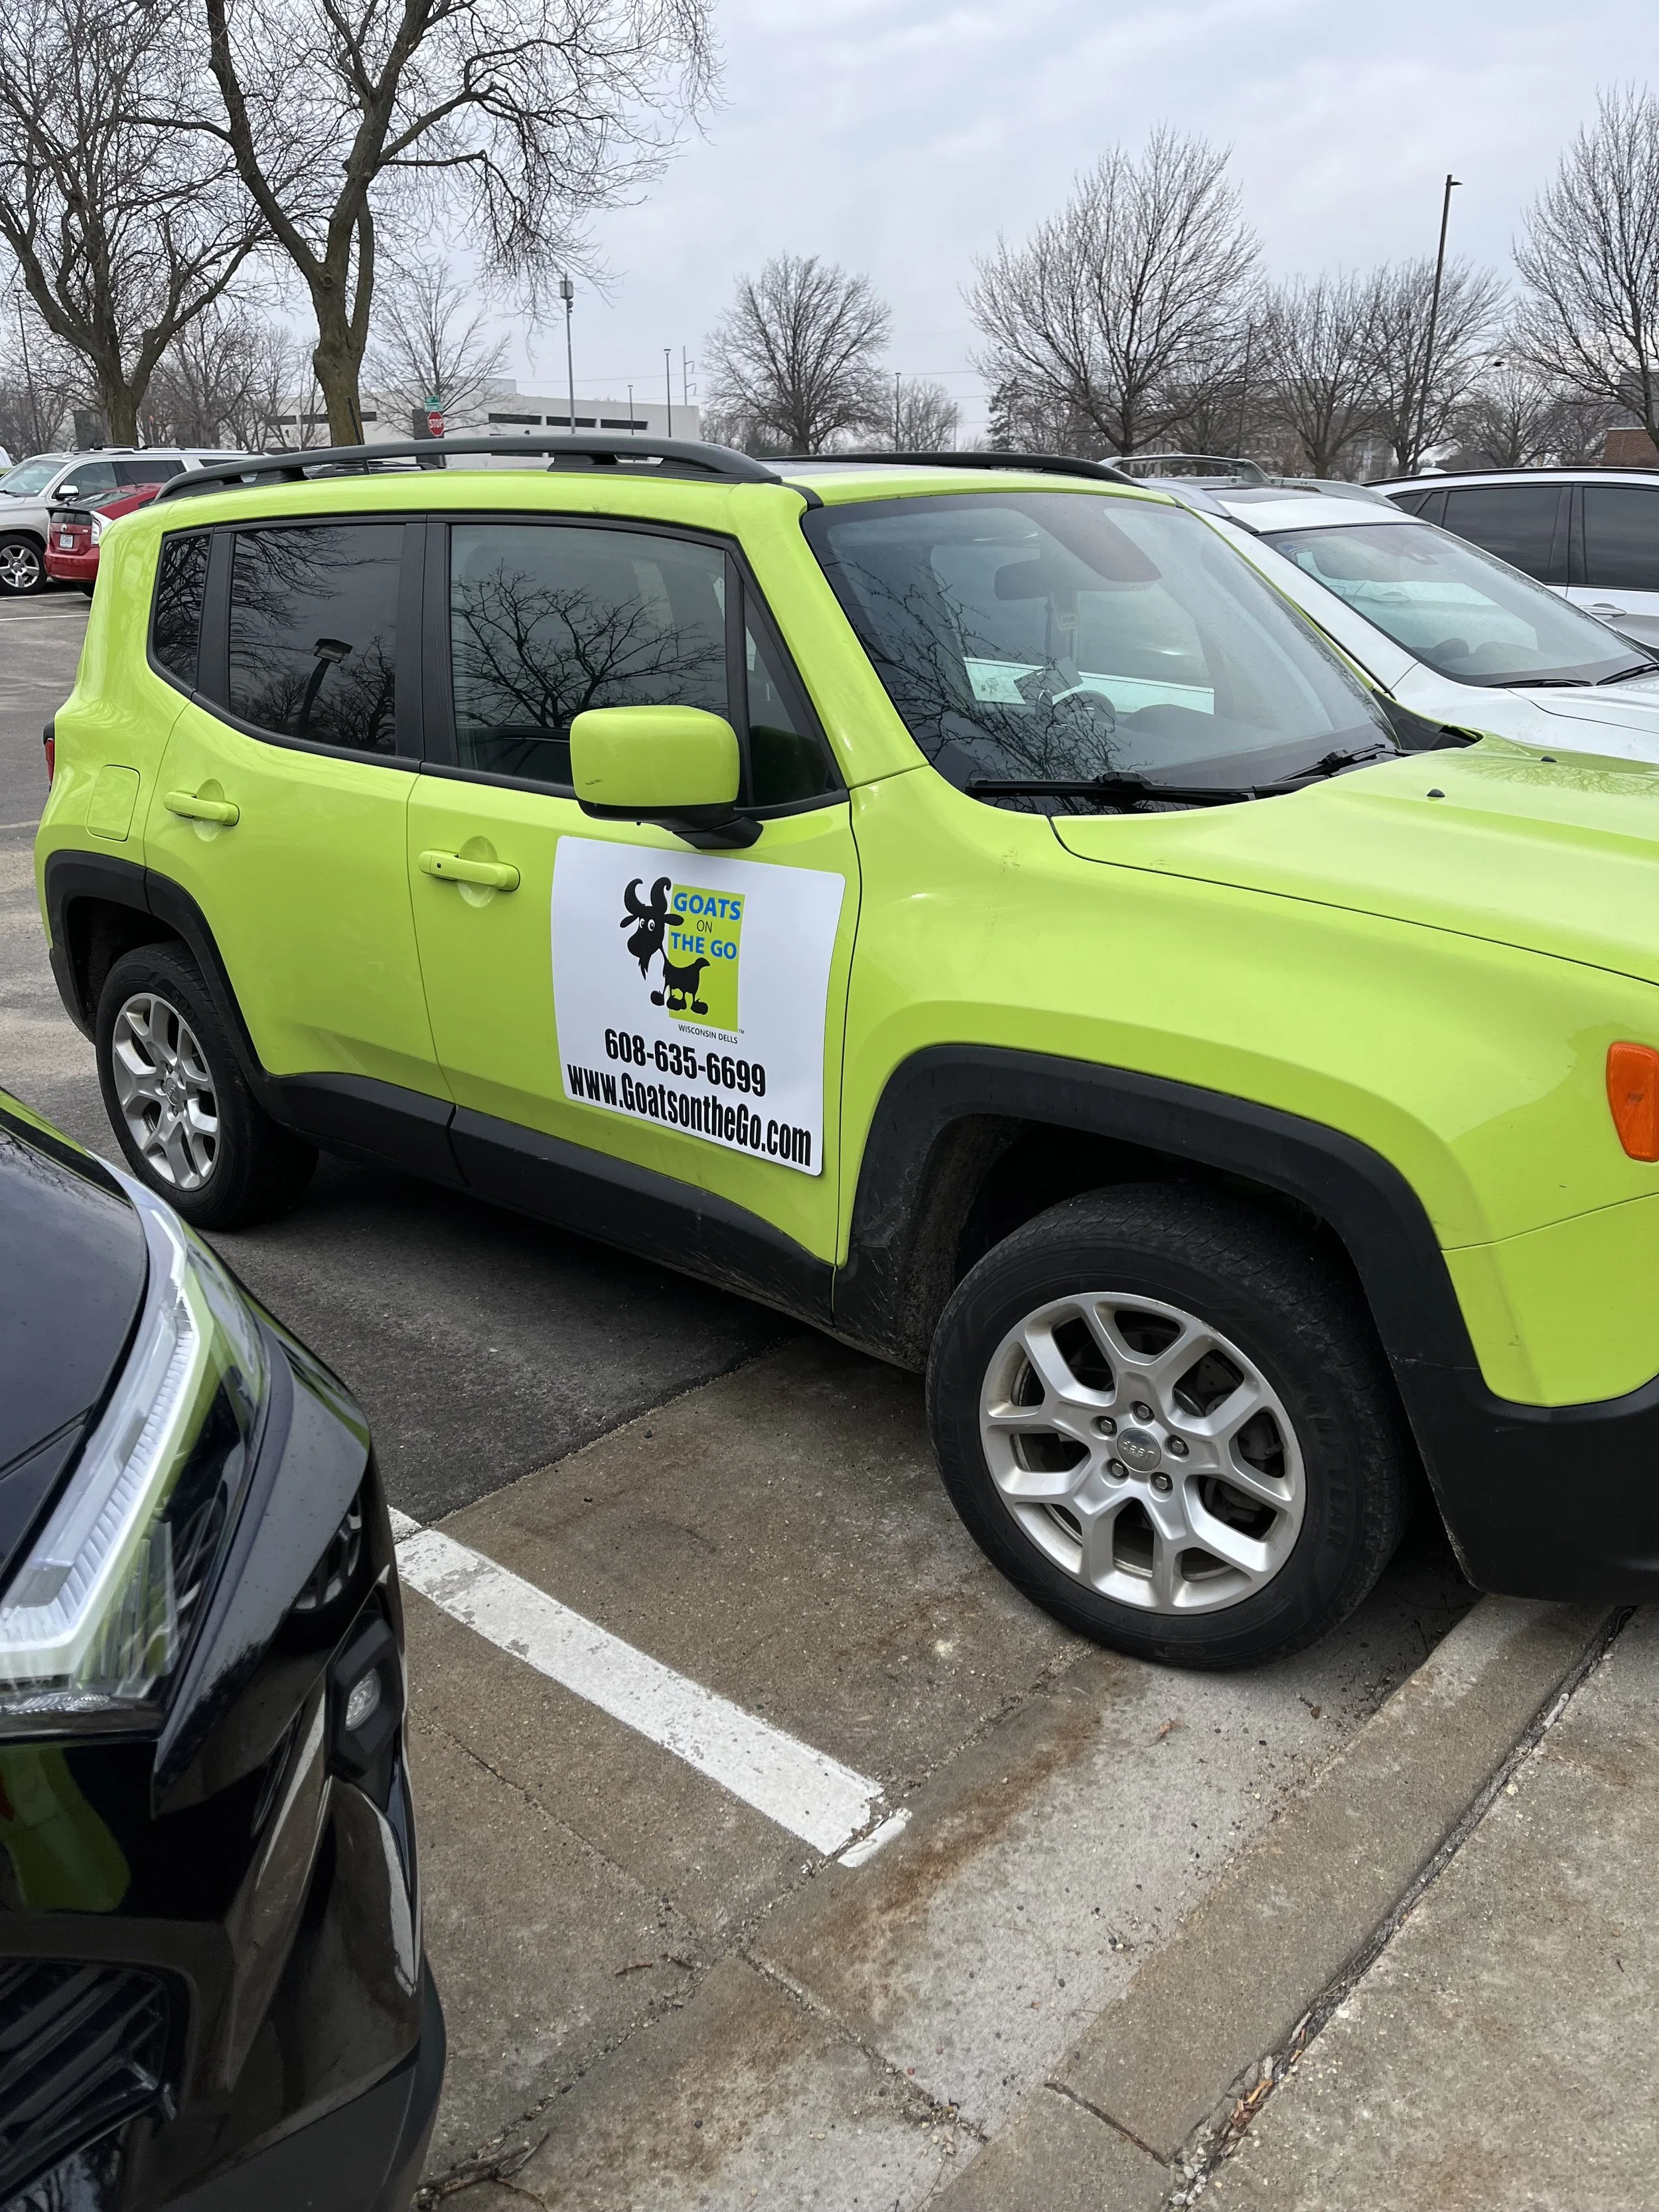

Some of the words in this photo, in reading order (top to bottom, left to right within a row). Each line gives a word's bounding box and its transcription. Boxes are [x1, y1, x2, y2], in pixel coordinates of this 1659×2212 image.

[429, 418, 443, 428] STOP
[674, 892, 741, 921] GOATS
[696, 919, 713, 933] ON
[670, 931, 705, 954] THE
[710, 939, 737, 960] GO
[678, 1024, 717, 1039] WISCONSIN
[718, 1033, 738, 1044] DELLS
[605, 1028, 766, 1098] 608-635-6699
[567, 1063, 812, 1167] www.GoatsontheGo.com
